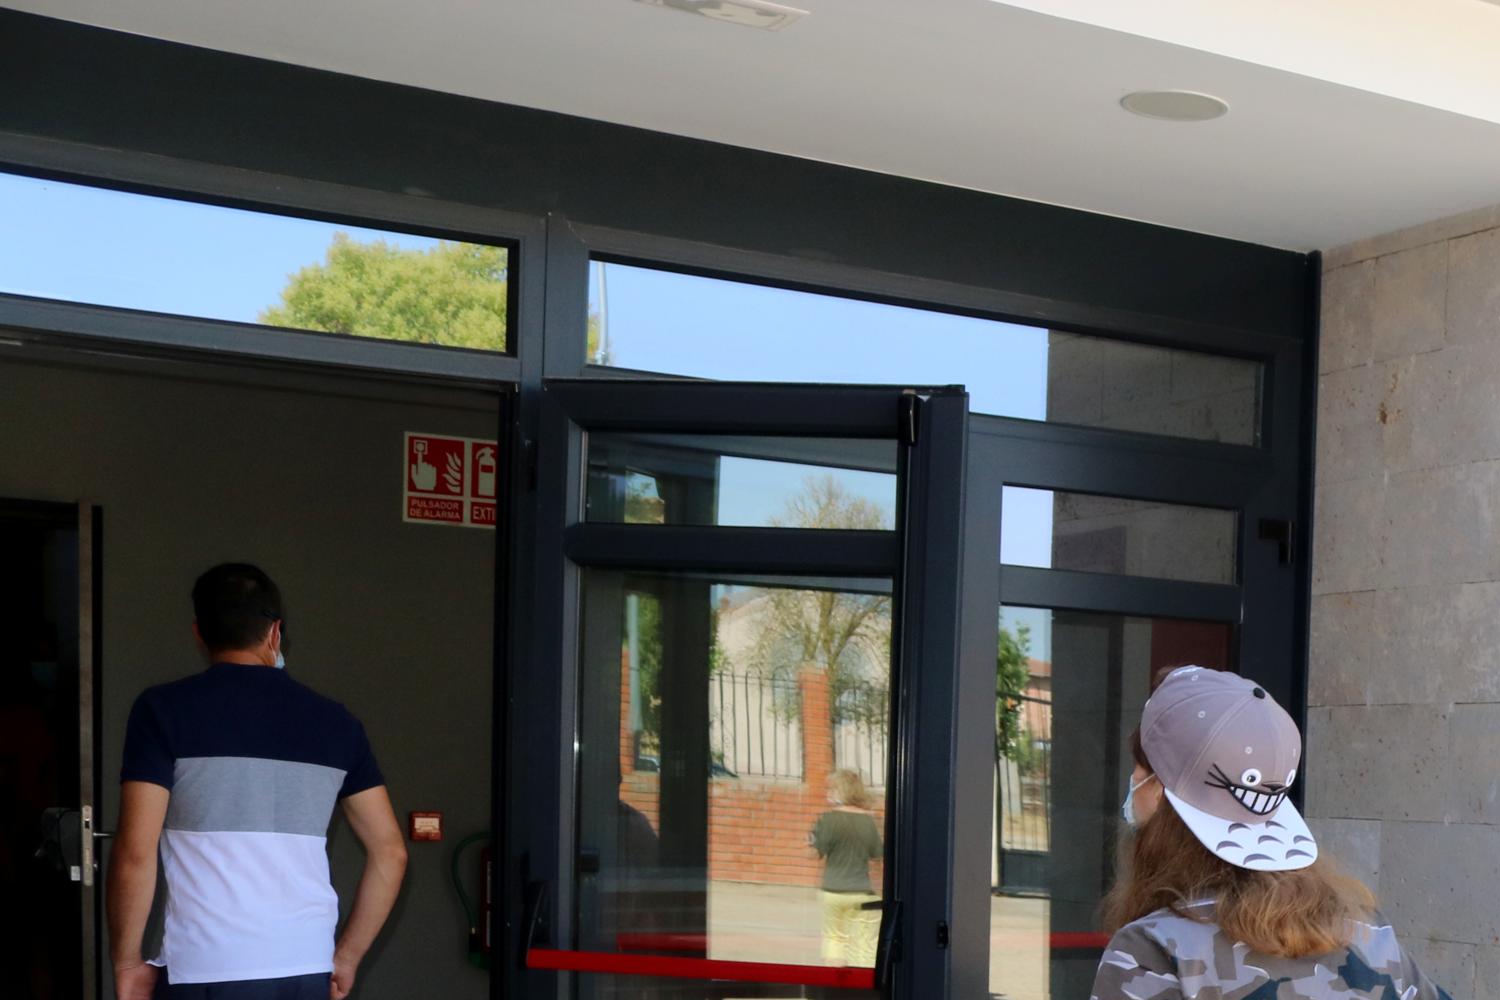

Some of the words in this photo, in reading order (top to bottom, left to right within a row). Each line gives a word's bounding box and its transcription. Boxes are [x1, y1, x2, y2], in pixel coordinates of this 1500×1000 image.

[411, 498, 459, 510] PULSADOR
[409, 507, 422, 517] DE
[423, 508, 461, 519] ALARMA
